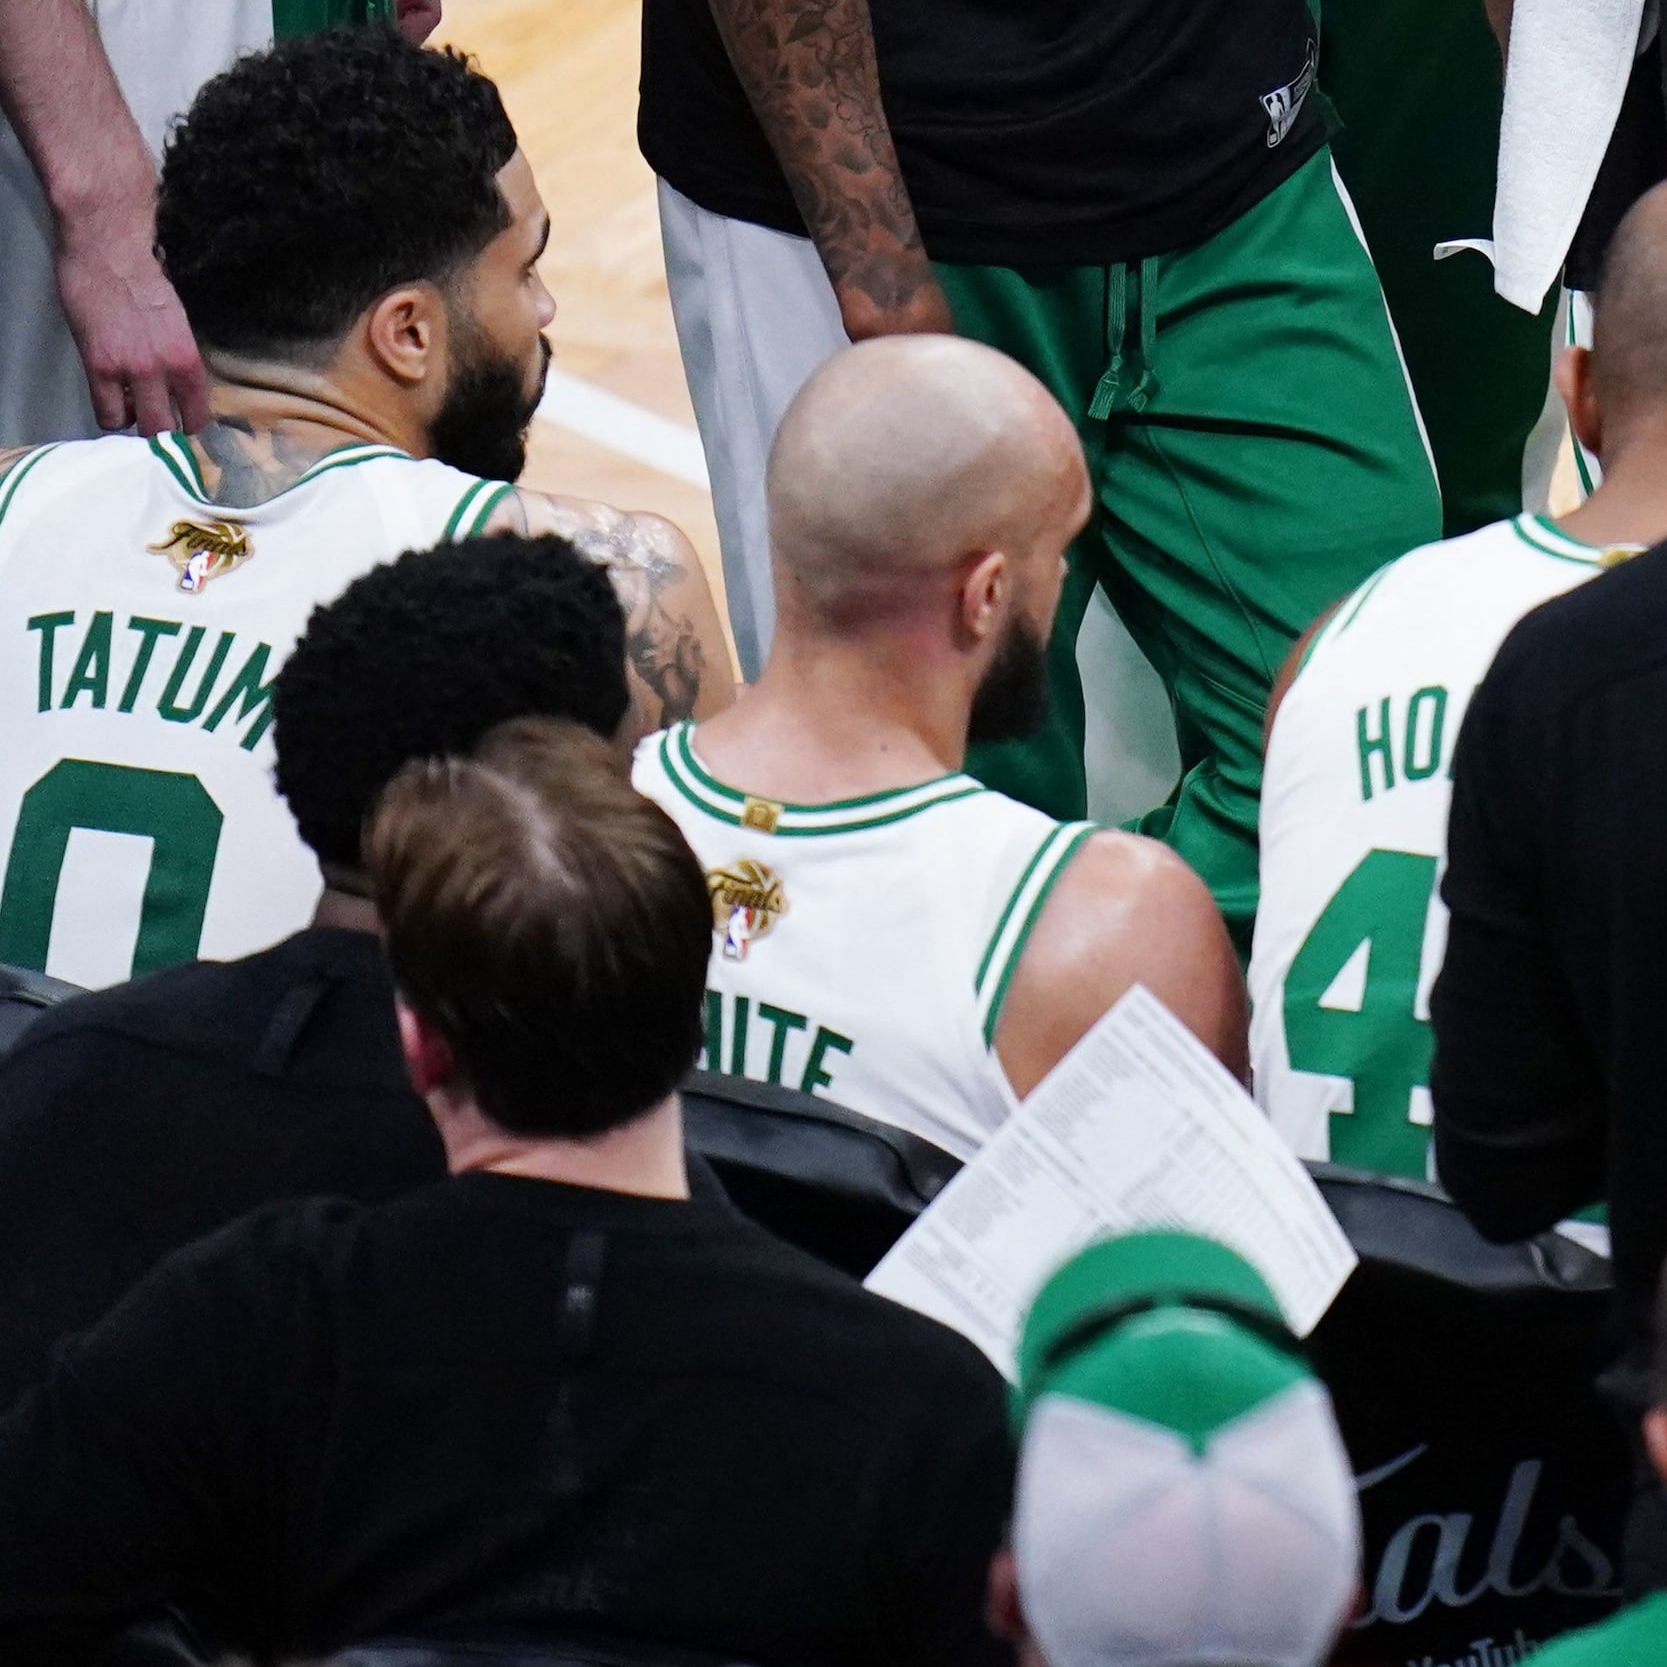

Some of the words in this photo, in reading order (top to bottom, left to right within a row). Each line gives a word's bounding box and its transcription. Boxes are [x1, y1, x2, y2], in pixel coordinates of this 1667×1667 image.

[27, 609, 276, 752] TATUM
[1357, 685, 1454, 803] HO
[0, 757, 225, 982] 0
